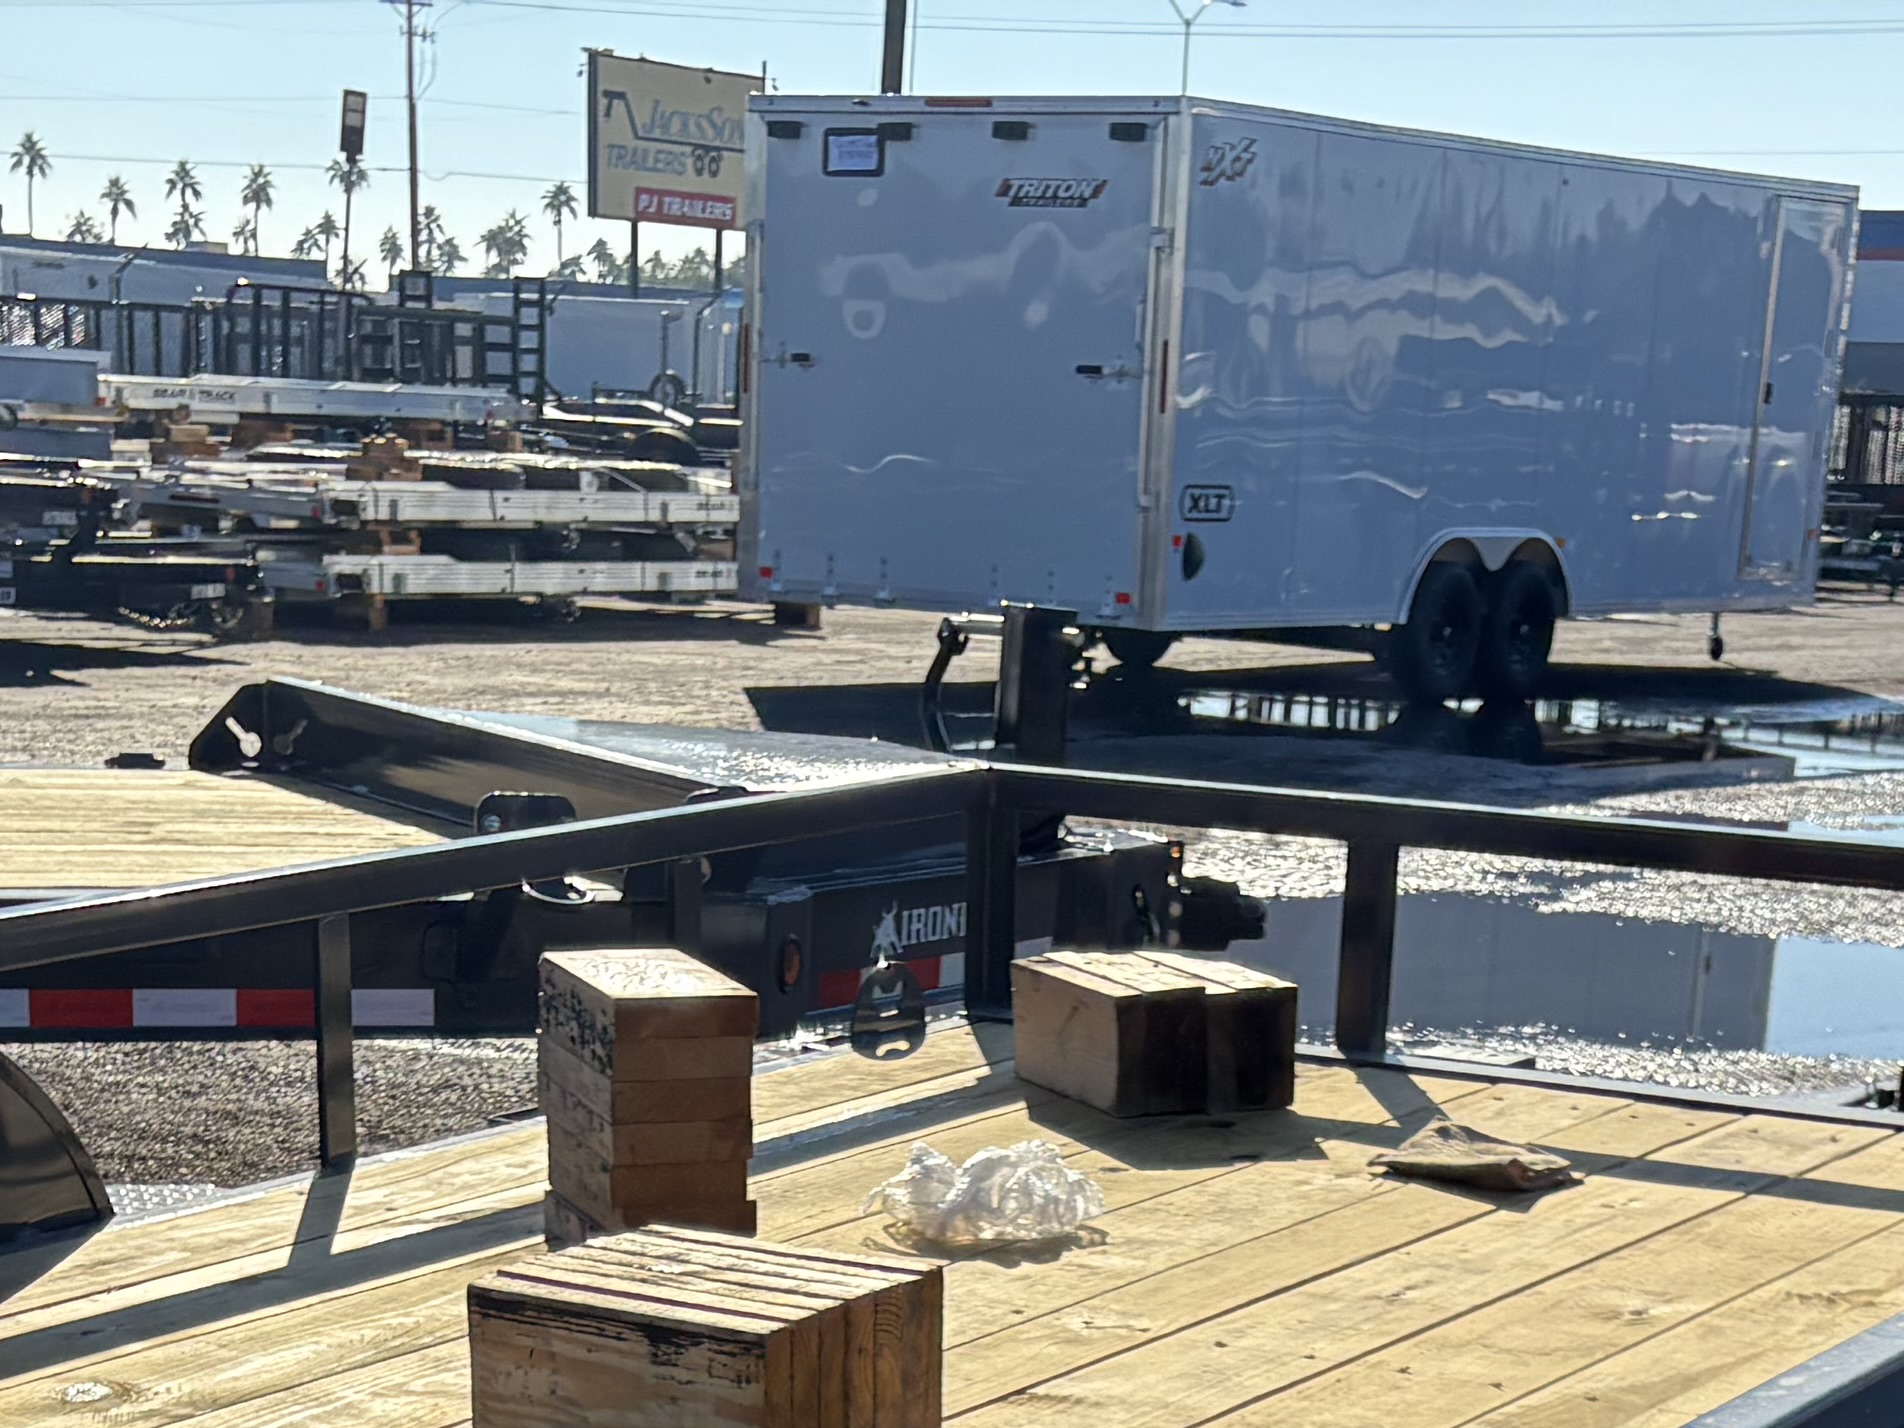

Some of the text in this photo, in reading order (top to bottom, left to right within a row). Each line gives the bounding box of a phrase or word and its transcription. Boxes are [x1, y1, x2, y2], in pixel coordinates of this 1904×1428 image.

[606, 143, 688, 176] TRAILERS
[1007, 179, 1097, 199] TRITON
[637, 193, 734, 220] PJ TRAILERS
[1188, 493, 1227, 513] XLT
